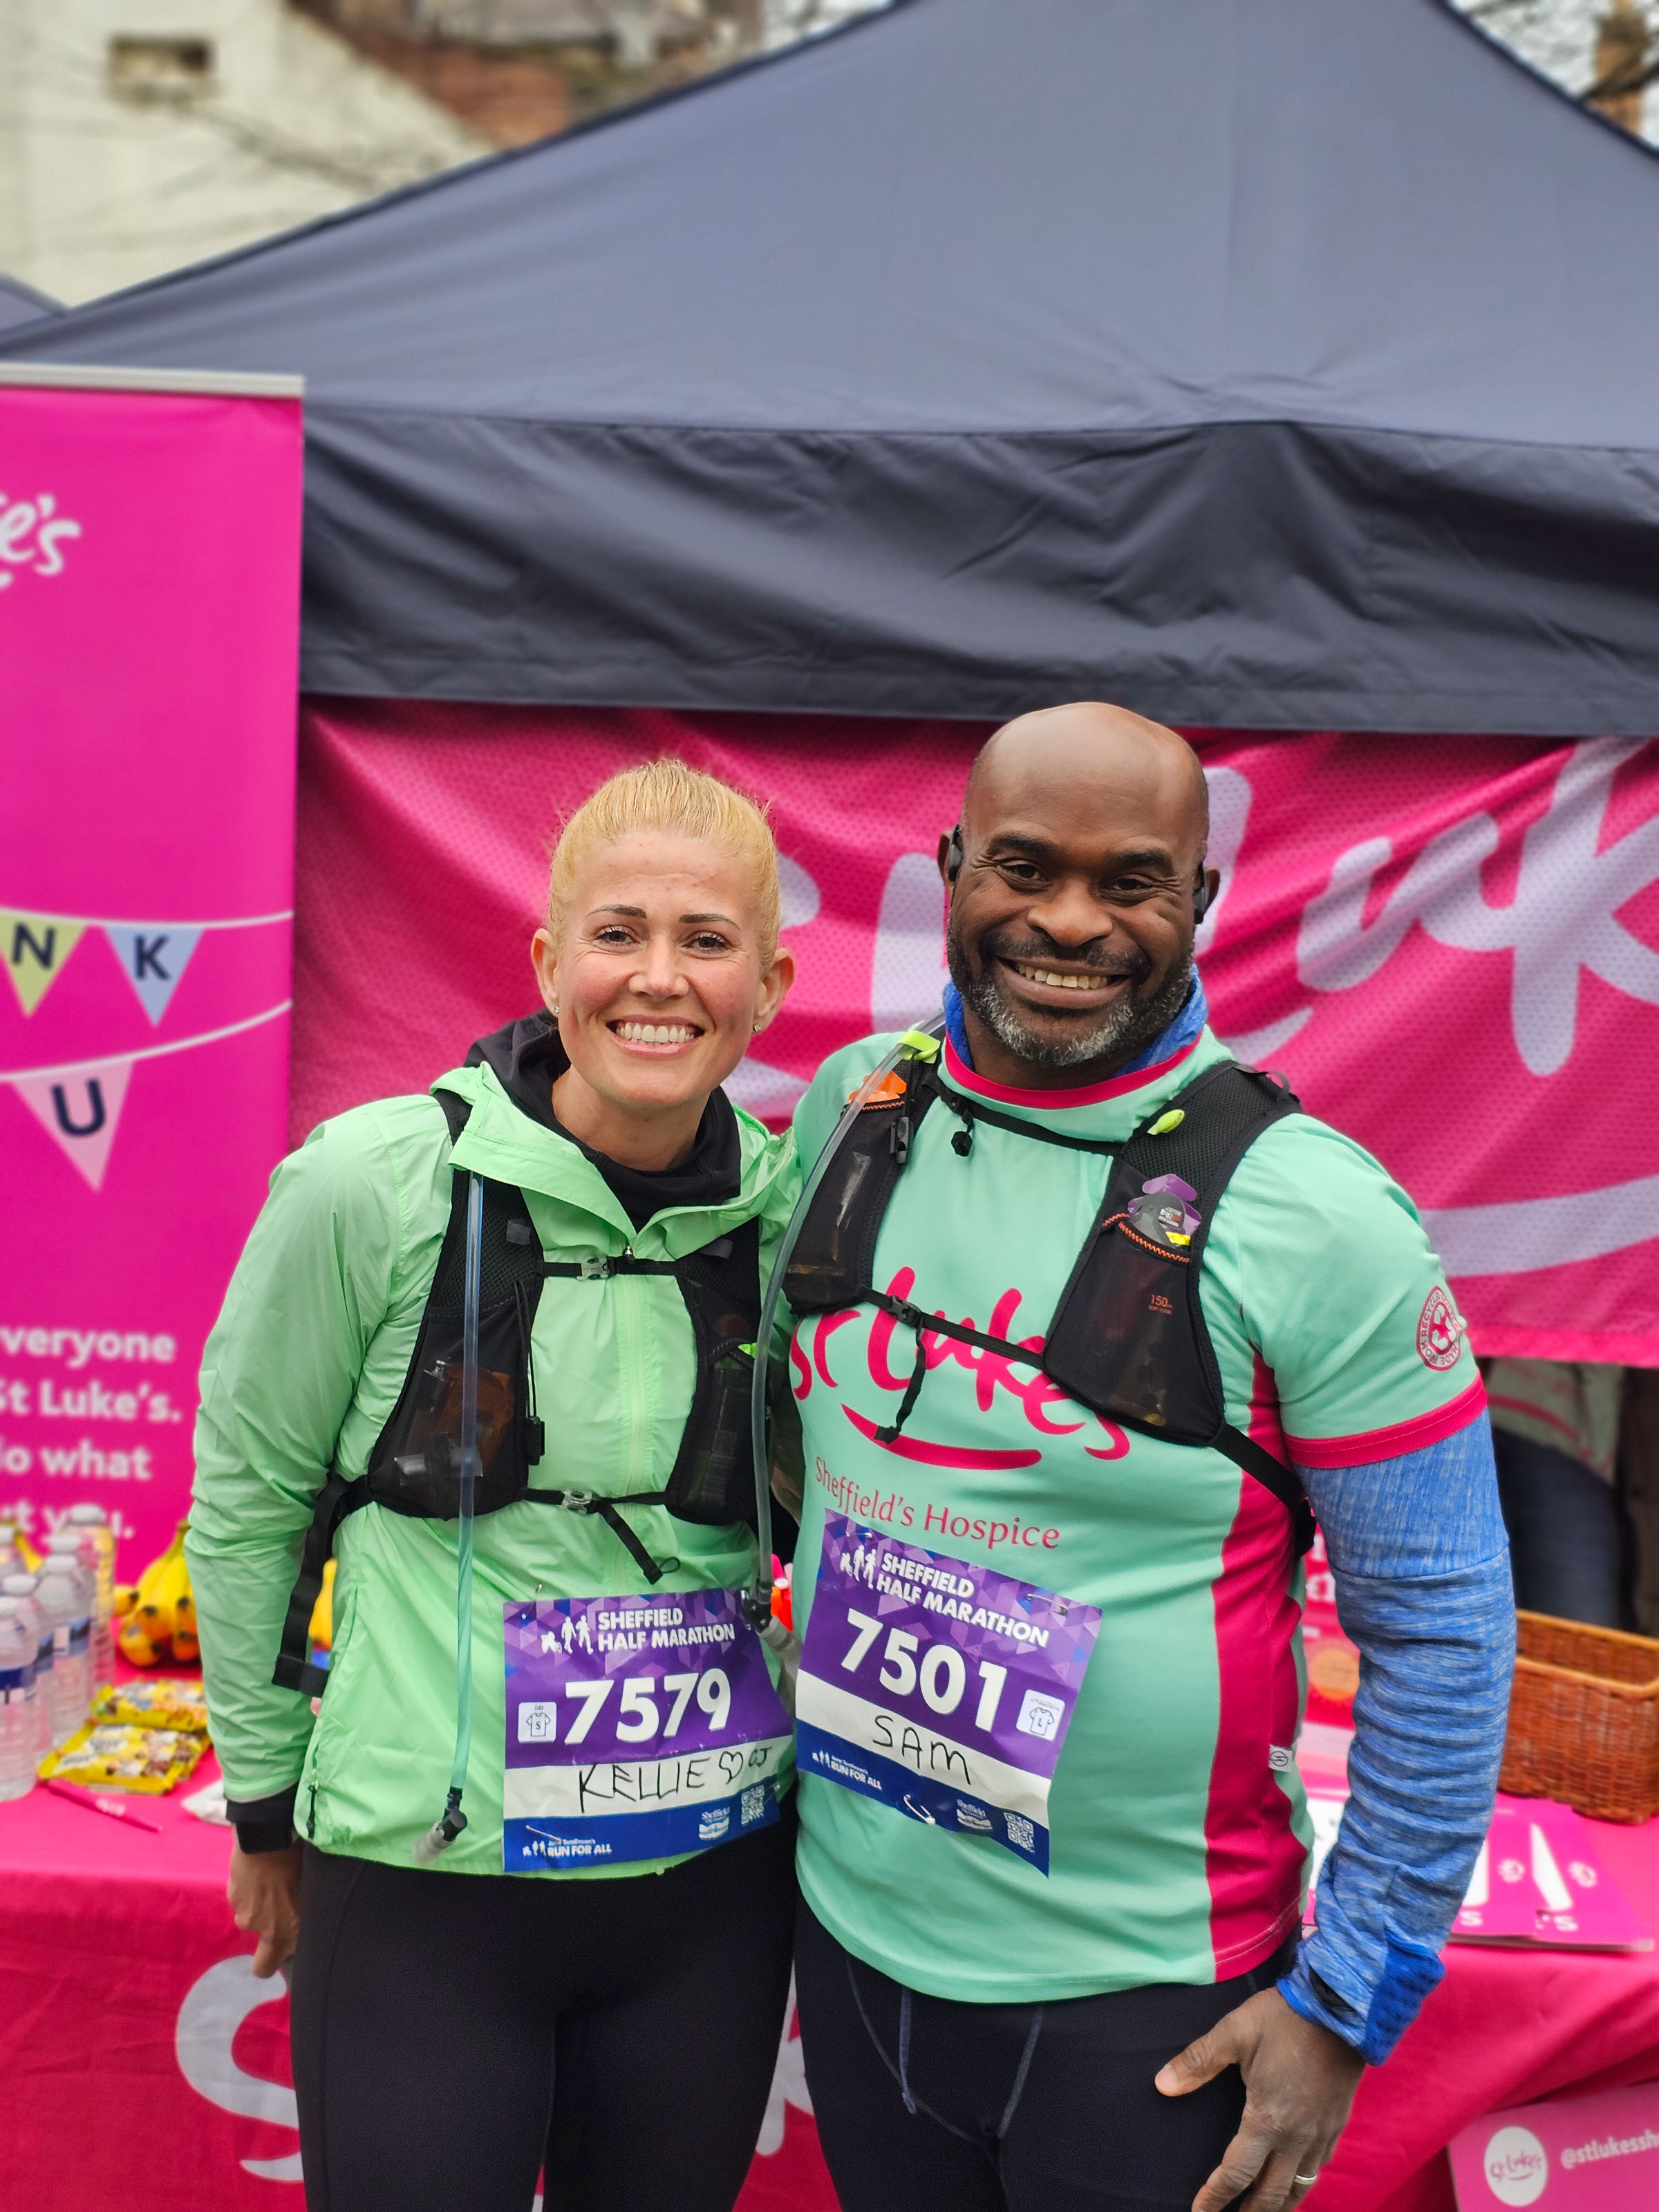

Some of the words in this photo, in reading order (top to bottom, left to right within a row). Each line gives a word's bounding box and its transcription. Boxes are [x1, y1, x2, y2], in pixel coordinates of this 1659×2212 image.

[0, 1327, 176, 1368] veryone
[41, 1438, 152, 1481] what
[816, 1456, 914, 1528] Sheffield's
[924, 1504, 1060, 1550] Hospice
[881, 1553, 975, 1599] SHEFFIELD
[598, 1608, 683, 1631] SHEFFIELD
[877, 1573, 921, 1604] HALF
[923, 1595, 1049, 1648] MARATHON
[598, 1630, 646, 1651] HALF
[651, 1623, 735, 1649] MARATHON
[841, 1607, 1008, 1732] 7501
[536, 1721, 541, 1730] S
[564, 1667, 731, 1745] 7579
[579, 1756, 711, 1814] KELLIE
[831, 1761, 849, 1778] RUN
[850, 1768, 866, 1784] FOR
[868, 1777, 883, 1792] ALL
[547, 1846, 570, 1857] RUN
[571, 1844, 592, 1856] FOR
[594, 1844, 612, 1855] ALL
